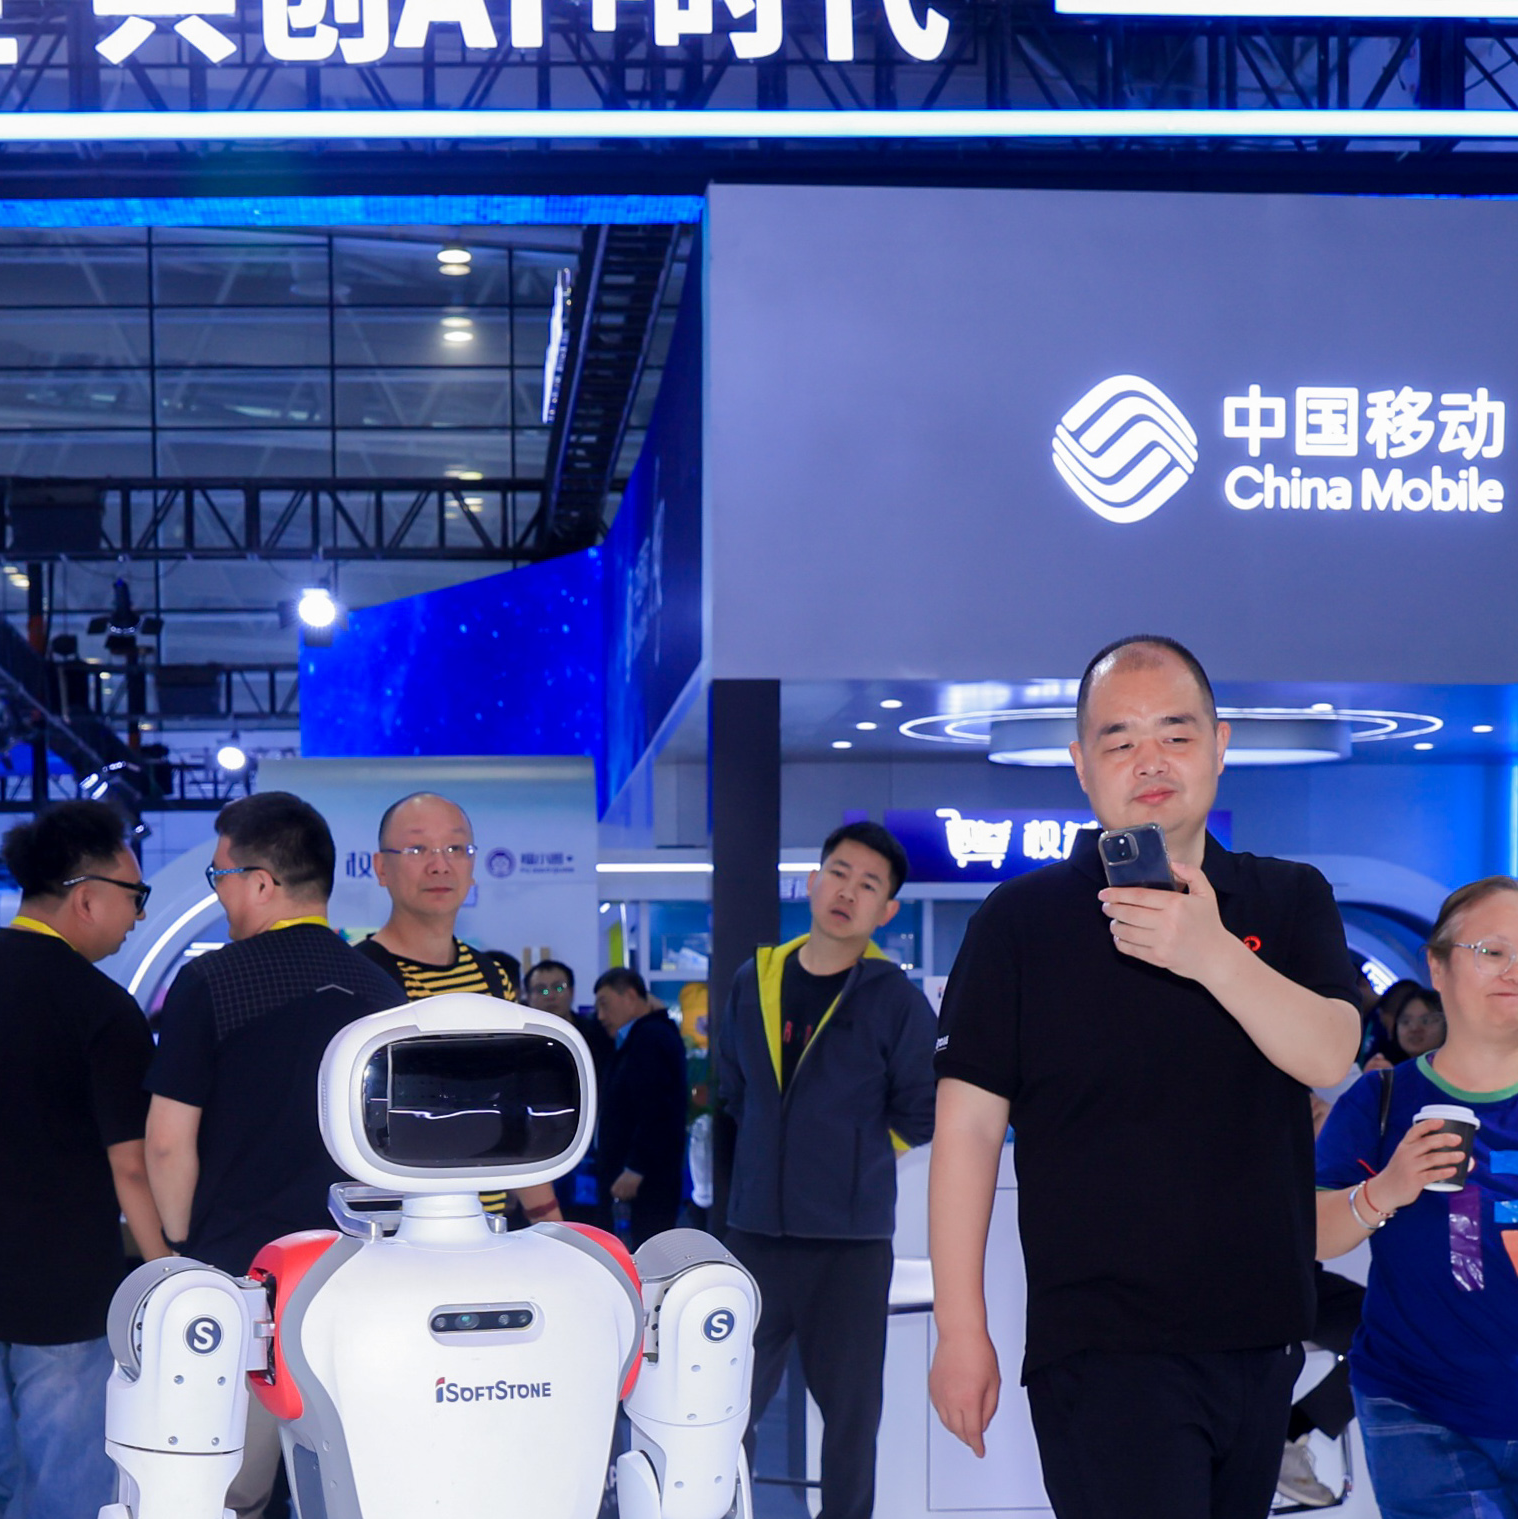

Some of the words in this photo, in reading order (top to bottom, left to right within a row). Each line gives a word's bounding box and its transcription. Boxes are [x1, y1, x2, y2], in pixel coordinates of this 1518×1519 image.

[1223, 384, 1506, 461] 中国移动
[1224, 464, 1353, 511] China
[1361, 466, 1505, 513] Mobile
[193, 1320, 214, 1351] S
[710, 1313, 729, 1339] S
